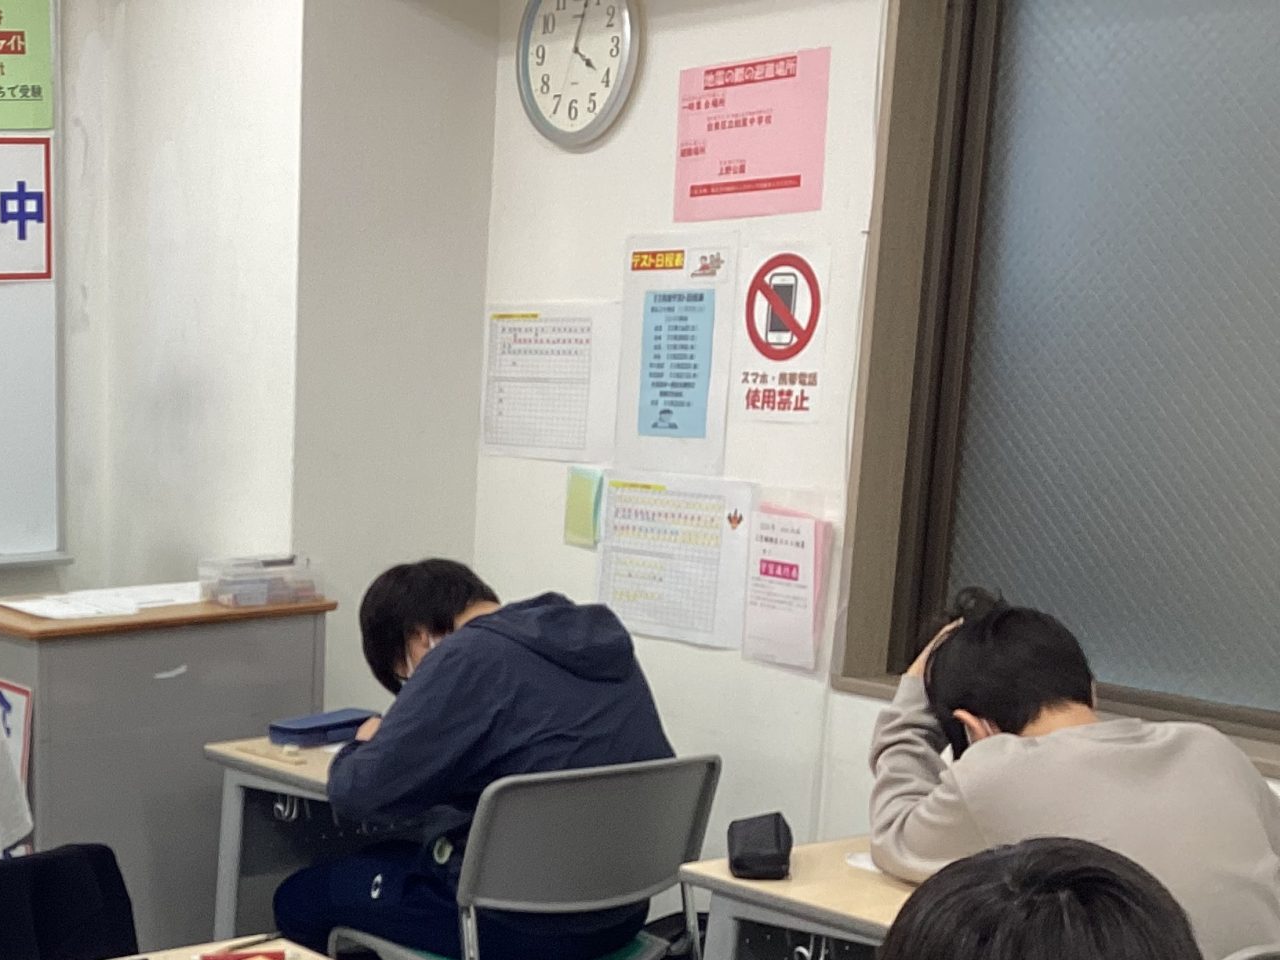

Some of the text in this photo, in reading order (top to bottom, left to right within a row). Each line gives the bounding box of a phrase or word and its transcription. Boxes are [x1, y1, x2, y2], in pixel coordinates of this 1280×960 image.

[542, 12, 556, 35] 10
[606, 5, 616, 28] 2
[535, 44, 546, 66] 9
[609, 35, 620, 58] 3
[540, 73, 550, 95] 8
[600, 67, 611, 88] 4
[552, 93, 562, 115] 7
[567, 99, 579, 121] 6
[587, 92, 597, 114] 5
[745, 389, 809, 412] 使用禁止
